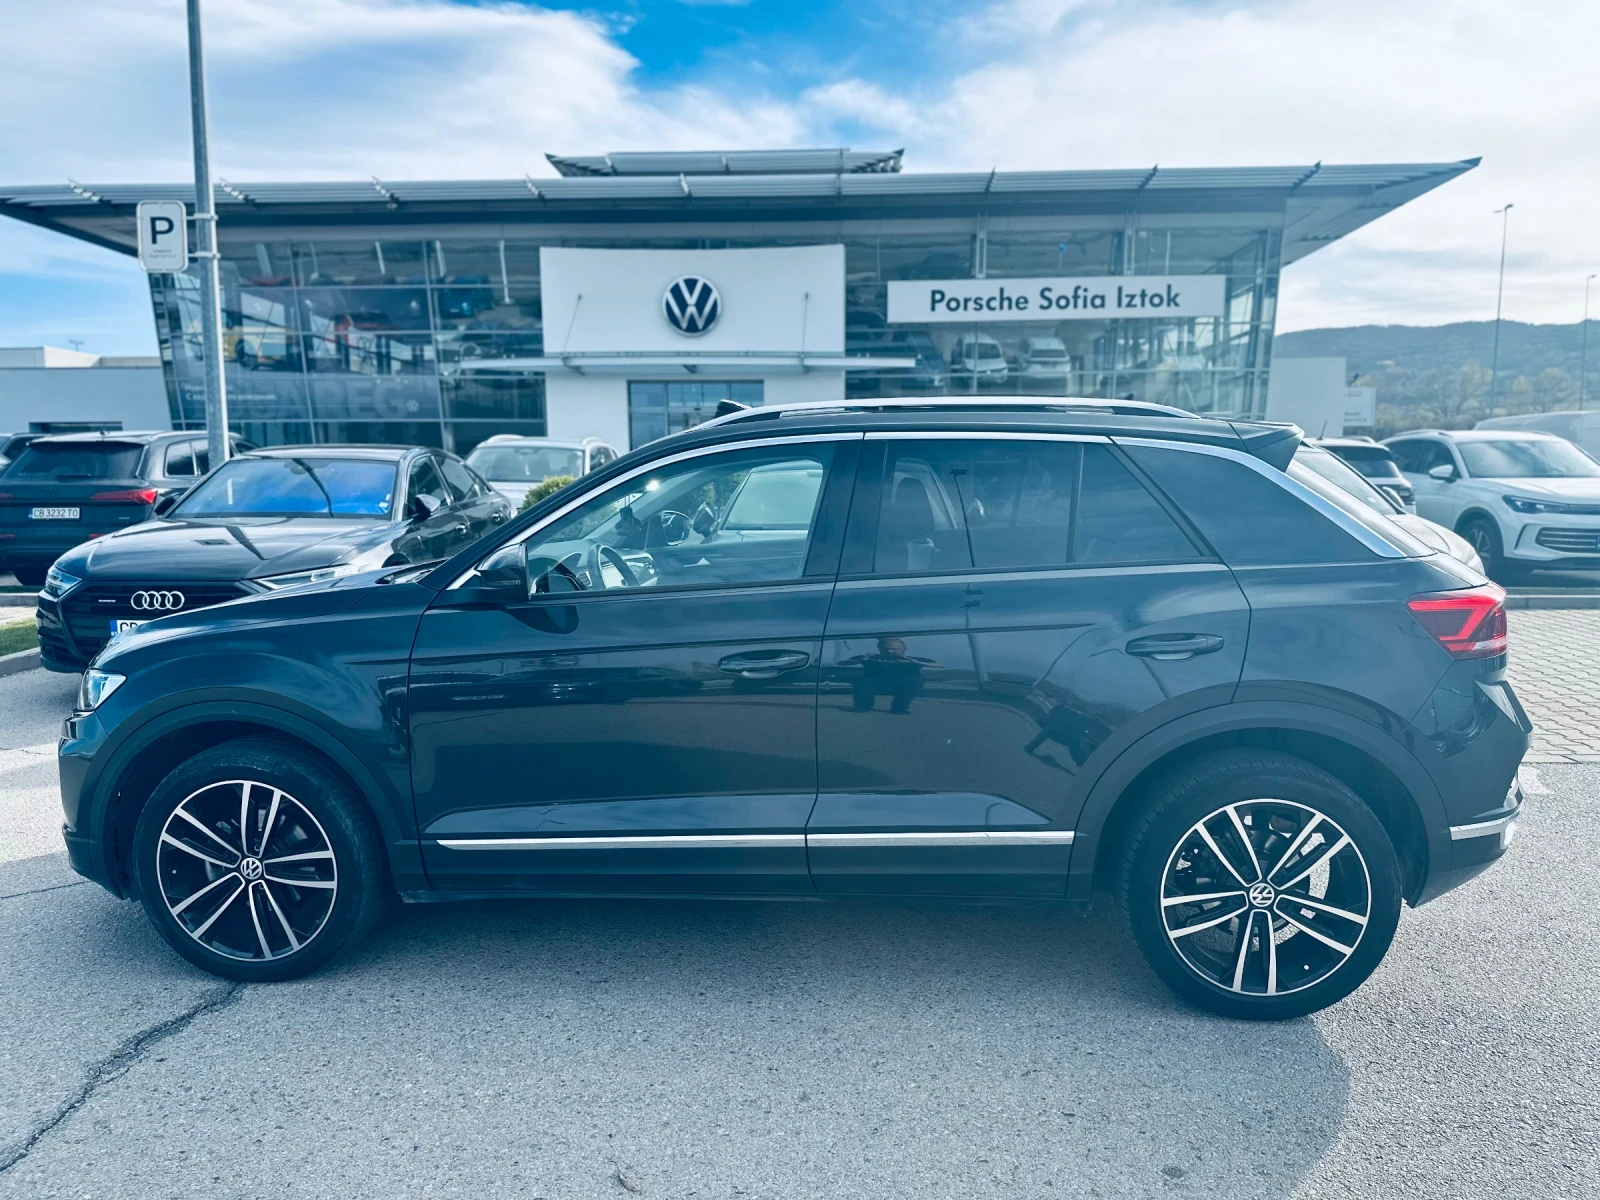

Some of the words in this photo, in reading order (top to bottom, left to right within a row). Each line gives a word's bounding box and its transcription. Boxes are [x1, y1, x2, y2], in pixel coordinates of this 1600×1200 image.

[149, 216, 175, 245] P
[930, 287, 1029, 312] Porsche
[1039, 285, 1106, 311] Sofia
[1117, 283, 1181, 308] Iztok
[33, 508, 45, 518] CB
[46, 508, 66, 518] 3232
[67, 508, 79, 518] TO
